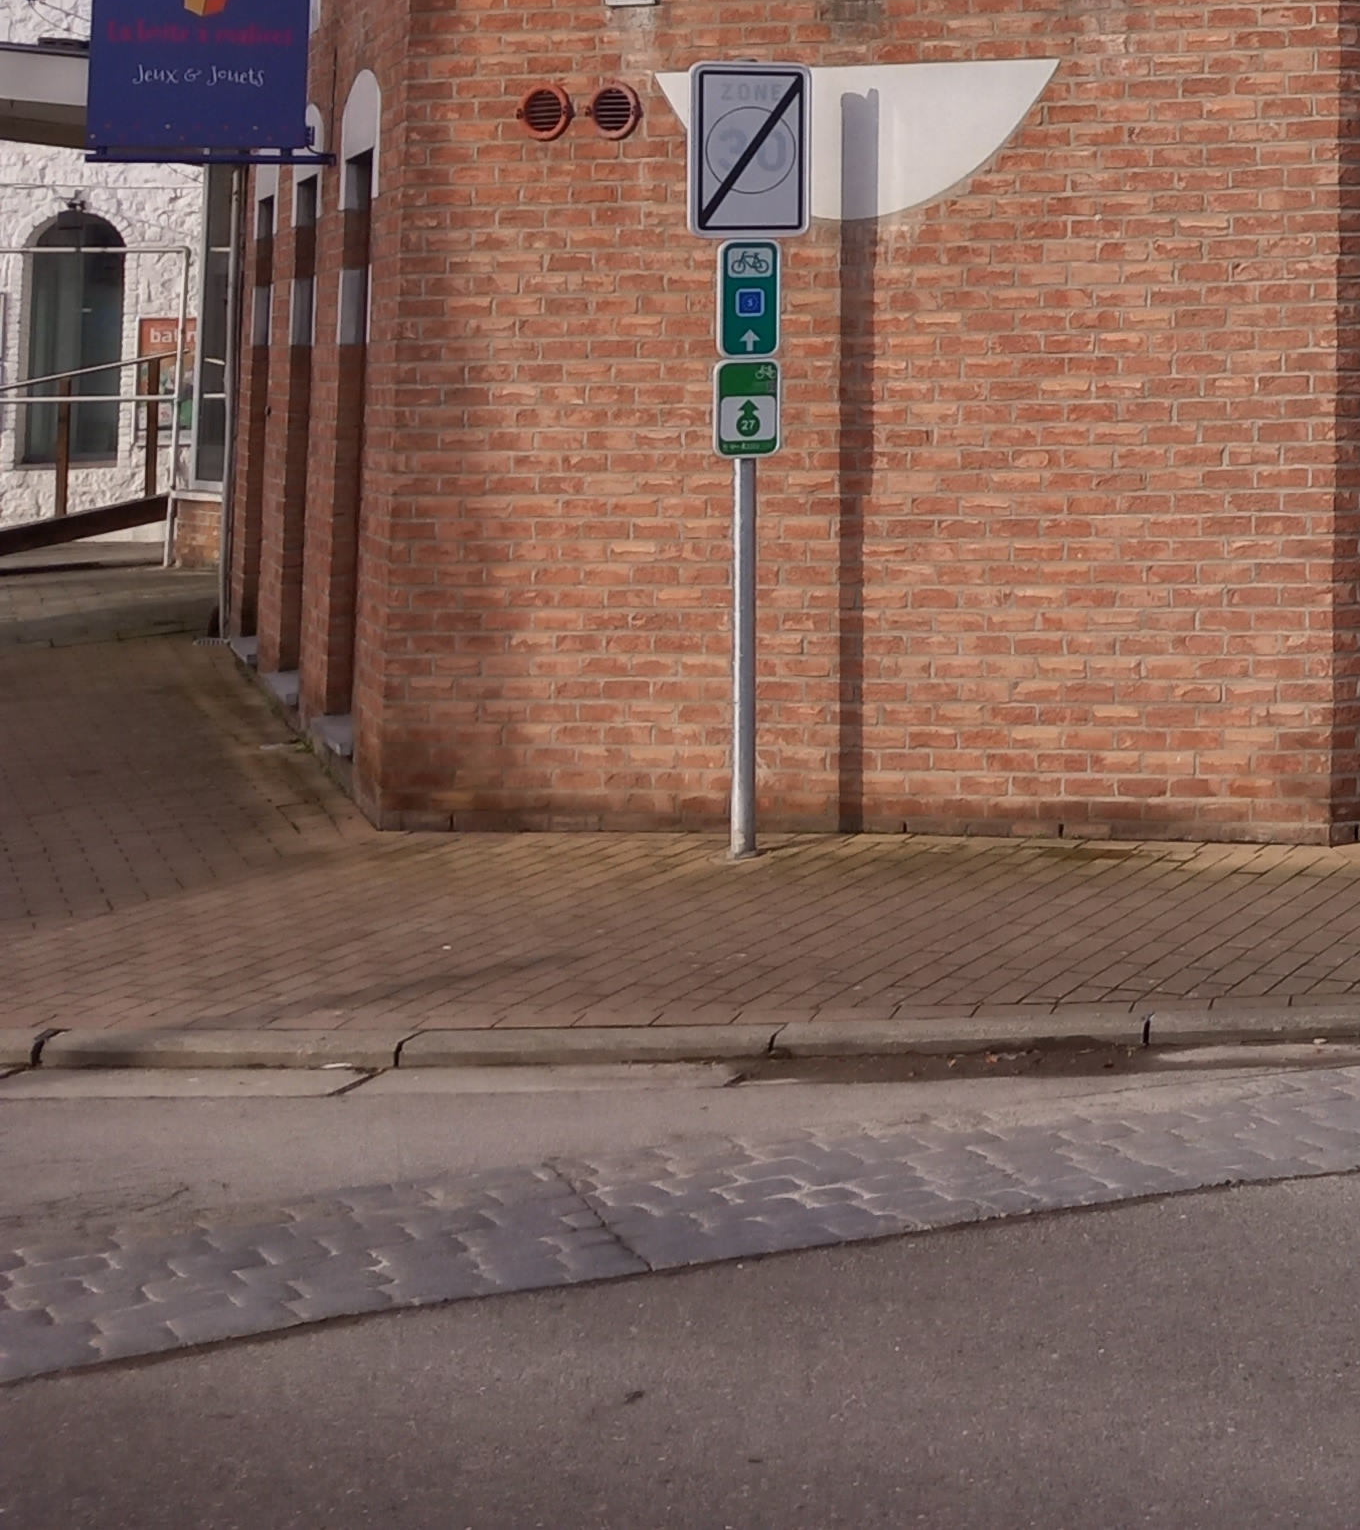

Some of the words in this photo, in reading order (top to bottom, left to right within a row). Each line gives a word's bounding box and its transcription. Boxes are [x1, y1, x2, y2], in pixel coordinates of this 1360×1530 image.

[132, 64, 179, 85] Jeux
[183, 68, 202, 83] &
[206, 65, 265, 88] Jouets
[720, 83, 783, 102] ZONE
[717, 128, 788, 172] 30
[740, 419, 756, 431] 27
